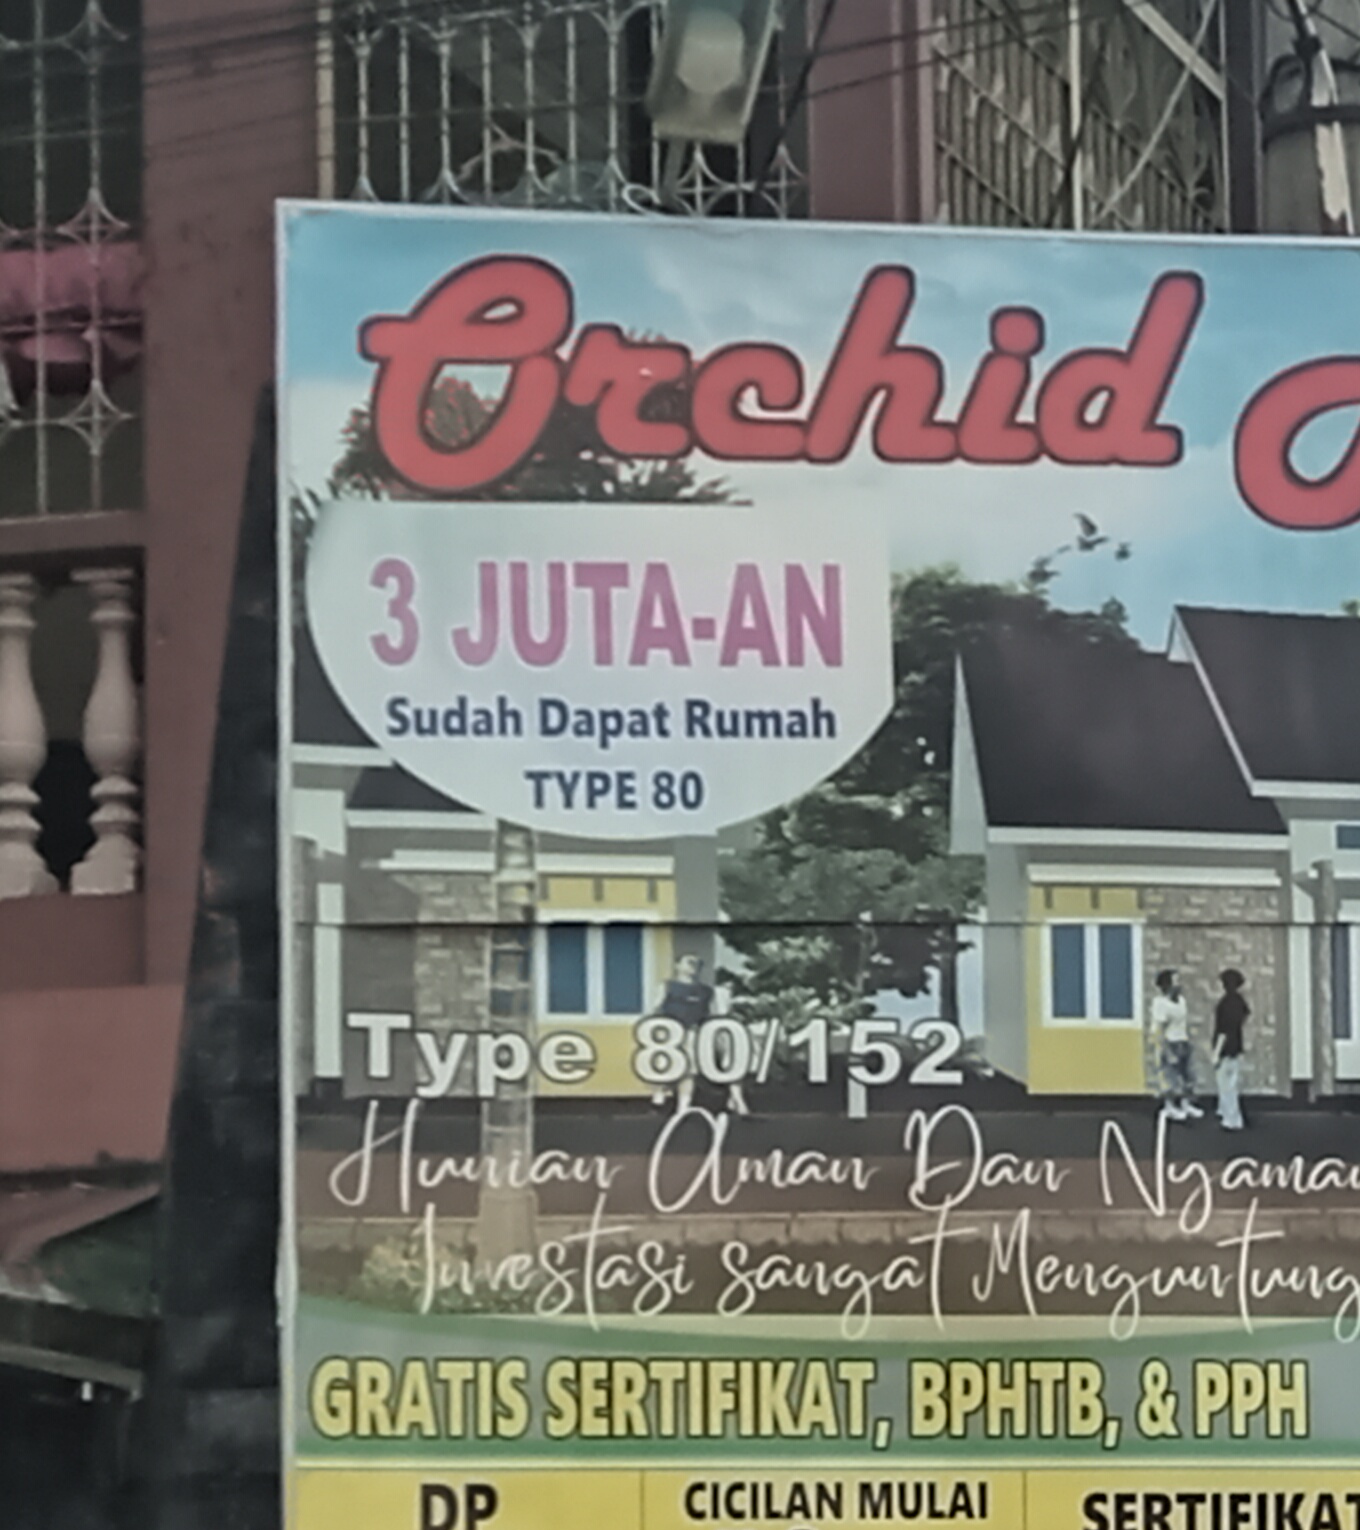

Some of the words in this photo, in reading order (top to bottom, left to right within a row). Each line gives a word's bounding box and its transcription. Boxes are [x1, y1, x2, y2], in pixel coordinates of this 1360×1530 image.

[357, 253, 1205, 494] Orchid
[369, 557, 420, 668] 3
[450, 560, 845, 669] JUTA-AN
[385, 696, 523, 740] Sudah
[538, 699, 671, 750] Dapat
[683, 697, 837, 741] Rumah
[524, 769, 639, 811] TYPE
[651, 770, 704, 811] 80
[345, 1012, 598, 1098] Type
[630, 1014, 966, 1090] 80/152
[328, 1094, 623, 1216] Hunian
[646, 1098, 882, 1216] Aman
[900, 1101, 1072, 1208] Dan
[400, 1200, 696, 1316] Investasi
[721, 1201, 954, 1337] sangat
[308, 1356, 527, 1442] GRATIS
[544, 1358, 893, 1451] SERTIFIKAT,
[909, 1358, 1122, 1451] BPHTB,
[1135, 1361, 1178, 1441] &
[1190, 1358, 1311, 1442] PPH
[682, 1484, 845, 1523] CICILAN
[858, 1484, 989, 1521] MULAI
